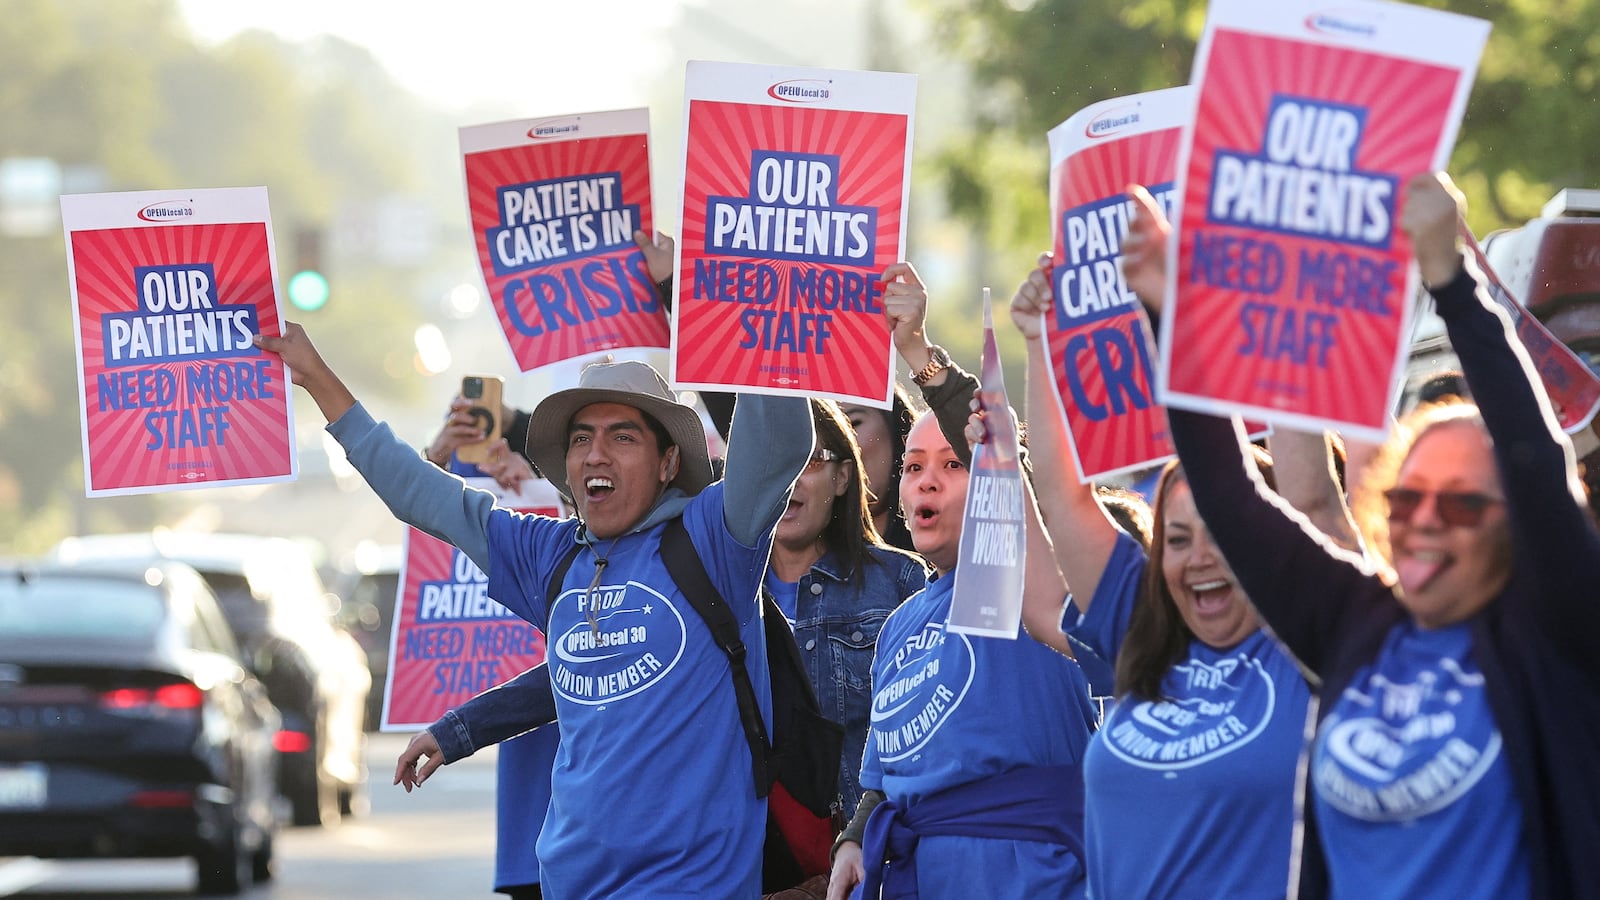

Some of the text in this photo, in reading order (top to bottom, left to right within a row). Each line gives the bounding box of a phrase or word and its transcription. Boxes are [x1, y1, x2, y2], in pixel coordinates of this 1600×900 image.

[778, 85, 830, 99] OPEIU Local 30
[1267, 101, 1359, 171] OUR
[503, 176, 615, 228] PATIENT
[757, 157, 832, 207] OUR
[1214, 155, 1393, 244] PATIENTS
[146, 208, 167, 218] OPEIU
[496, 208, 632, 267] CARE IS IN
[713, 203, 869, 258] PATIENTS
[143, 270, 213, 313] OUR
[502, 250, 661, 338] CRISIS
[693, 258, 883, 315] NEED MORE
[1191, 231, 1400, 316] NEED MORE
[109, 310, 254, 360] PATIENTS
[739, 308, 833, 355] STAFF
[1238, 302, 1340, 368] STAFF
[97, 360, 274, 412] NEED MORE
[1065, 318, 1156, 422] CRI
[144, 407, 230, 451] STAFF
[420, 583, 514, 619] PATIE
[404, 624, 538, 661] NEED MORE
[630, 626, 647, 643] 30
[433, 659, 502, 696] STAFF
[556, 652, 663, 697] UNION MEMBER
[878, 678, 906, 710] OPEIU
[926, 658, 940, 679] 30
[902, 683, 955, 747] MEMBER
[1160, 714, 1248, 761] MEMBER
